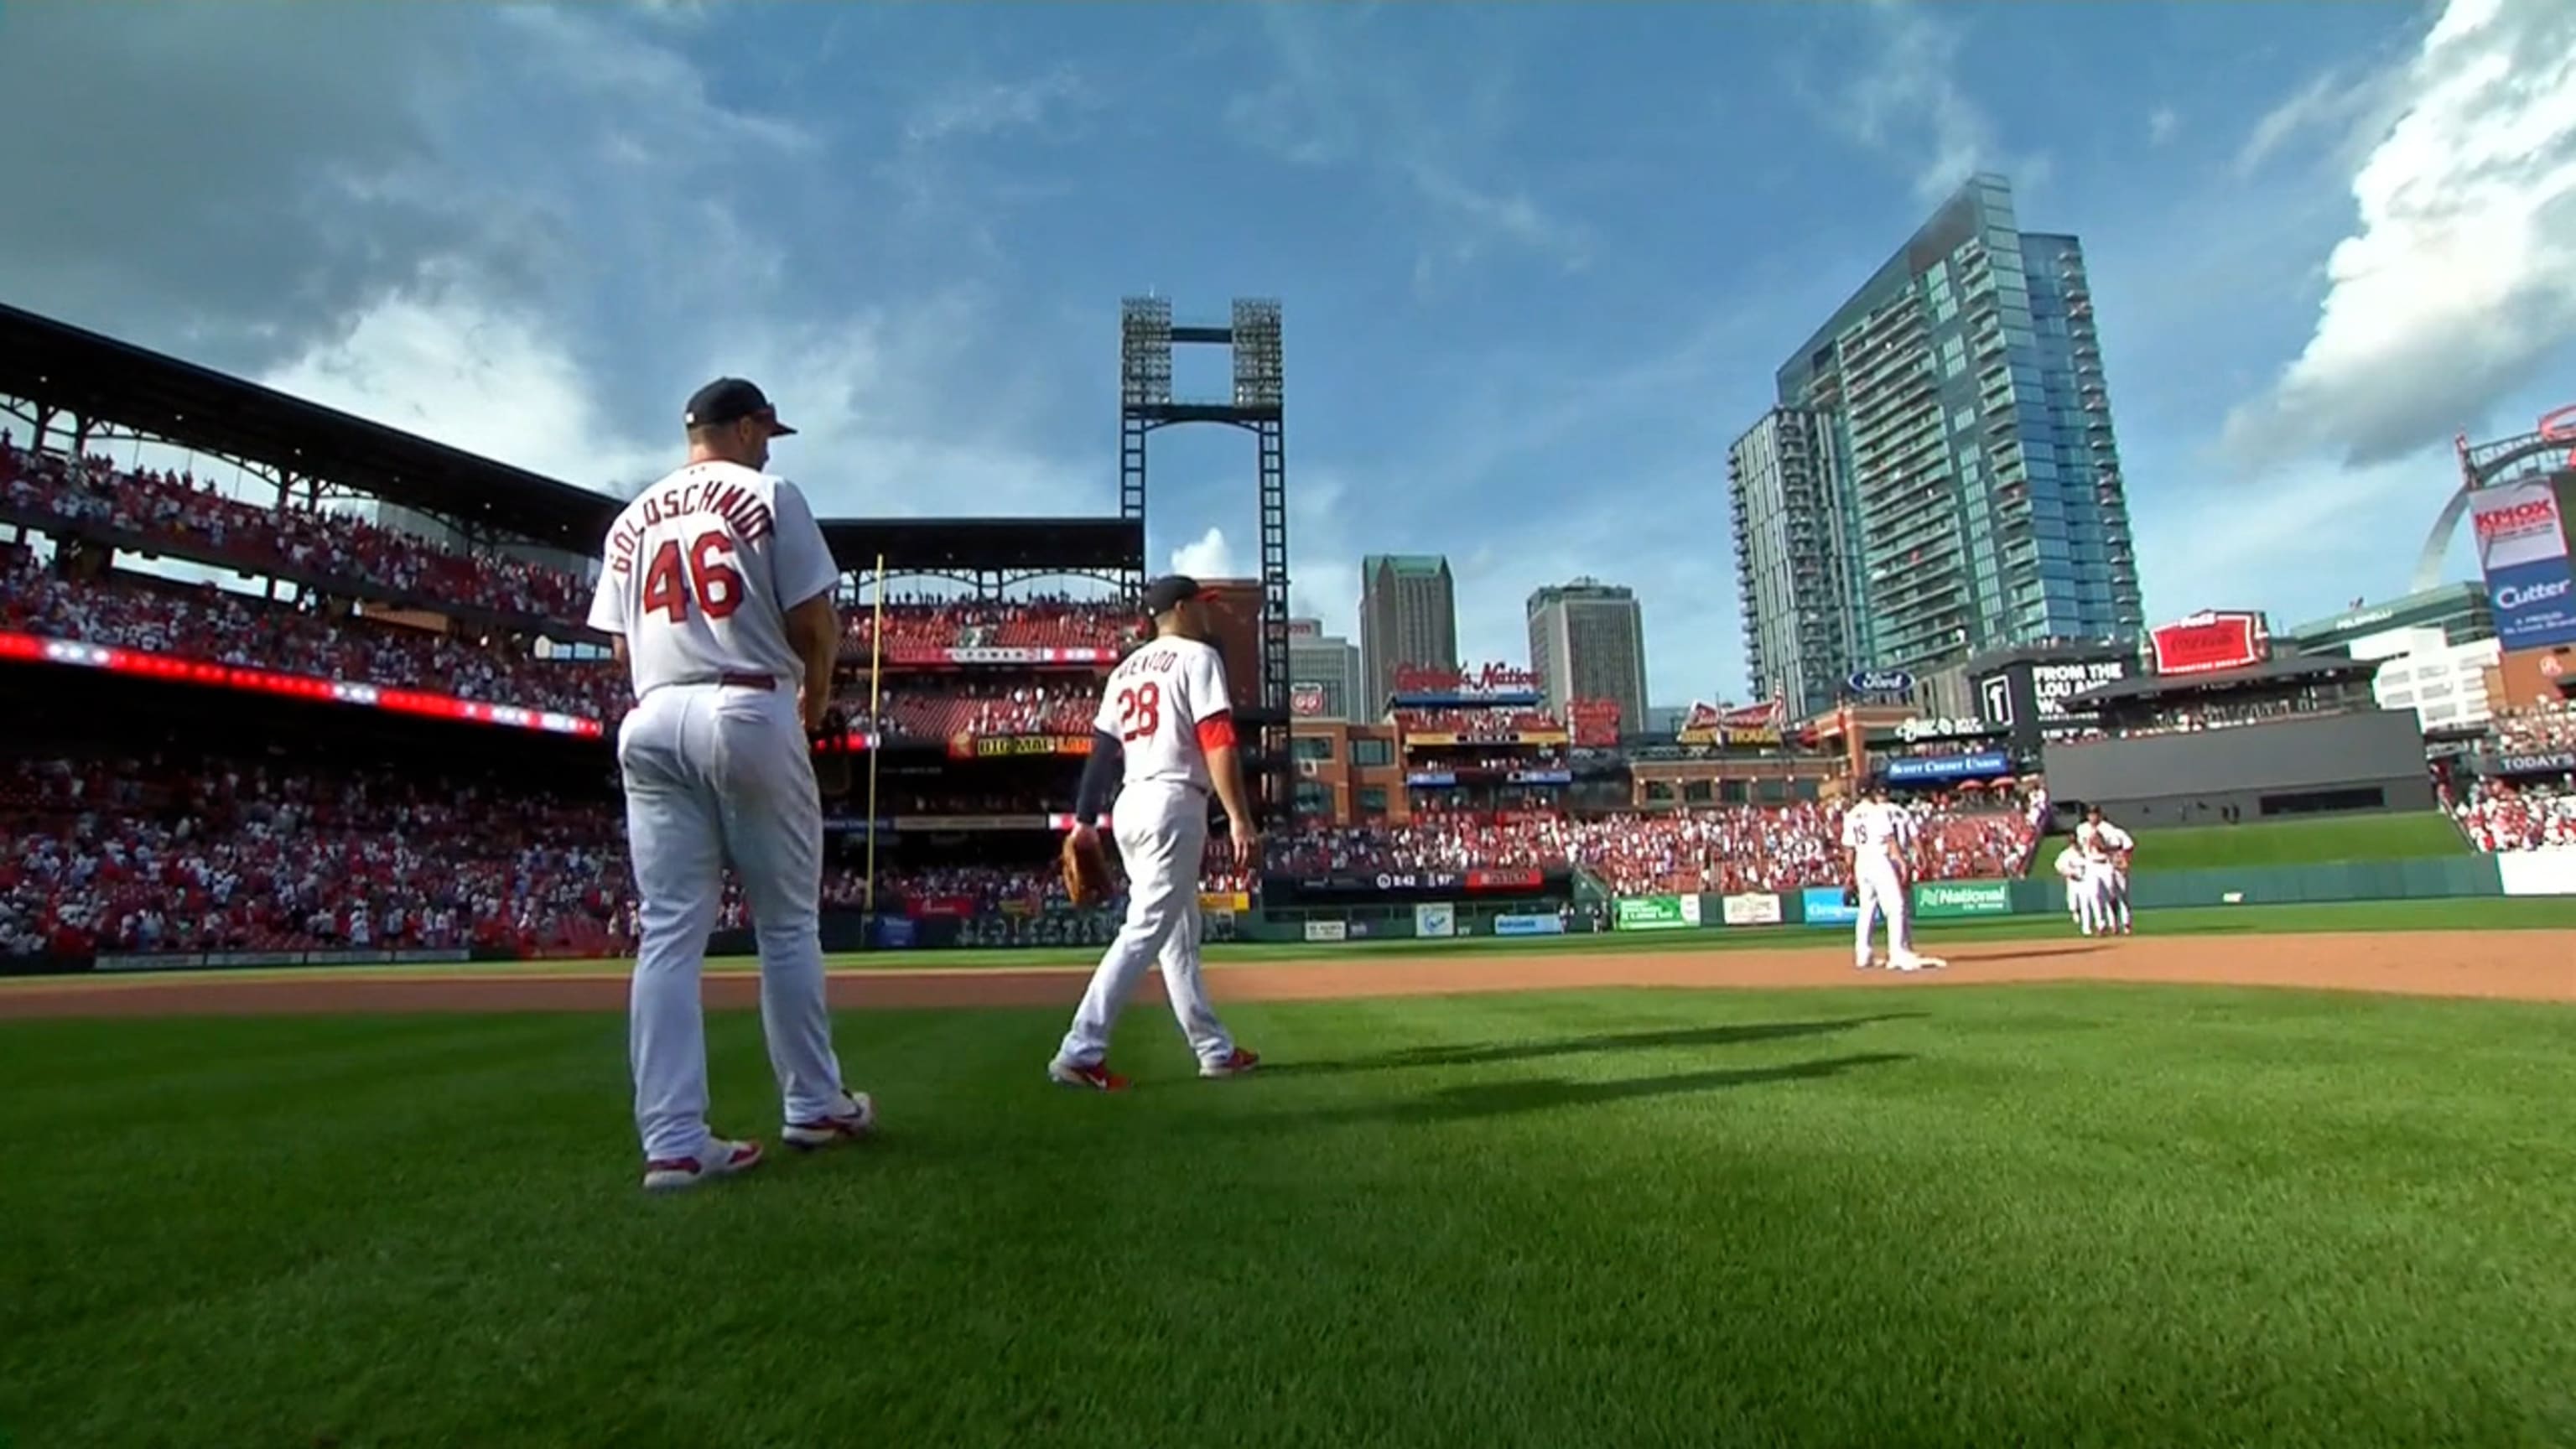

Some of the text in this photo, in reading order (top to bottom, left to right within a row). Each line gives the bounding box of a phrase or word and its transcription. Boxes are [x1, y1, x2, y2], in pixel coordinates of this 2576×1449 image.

[2475, 499, 2550, 527] KMOX
[643, 529, 745, 625] 46
[2496, 579, 2571, 610] Cutter
[1862, 672, 1902, 688] Ford
[2032, 662, 2124, 682] FROM THE
[2035, 681, 2072, 699] LOU
[1117, 681, 1160, 742] 28
[1940, 886, 2005, 904] National
